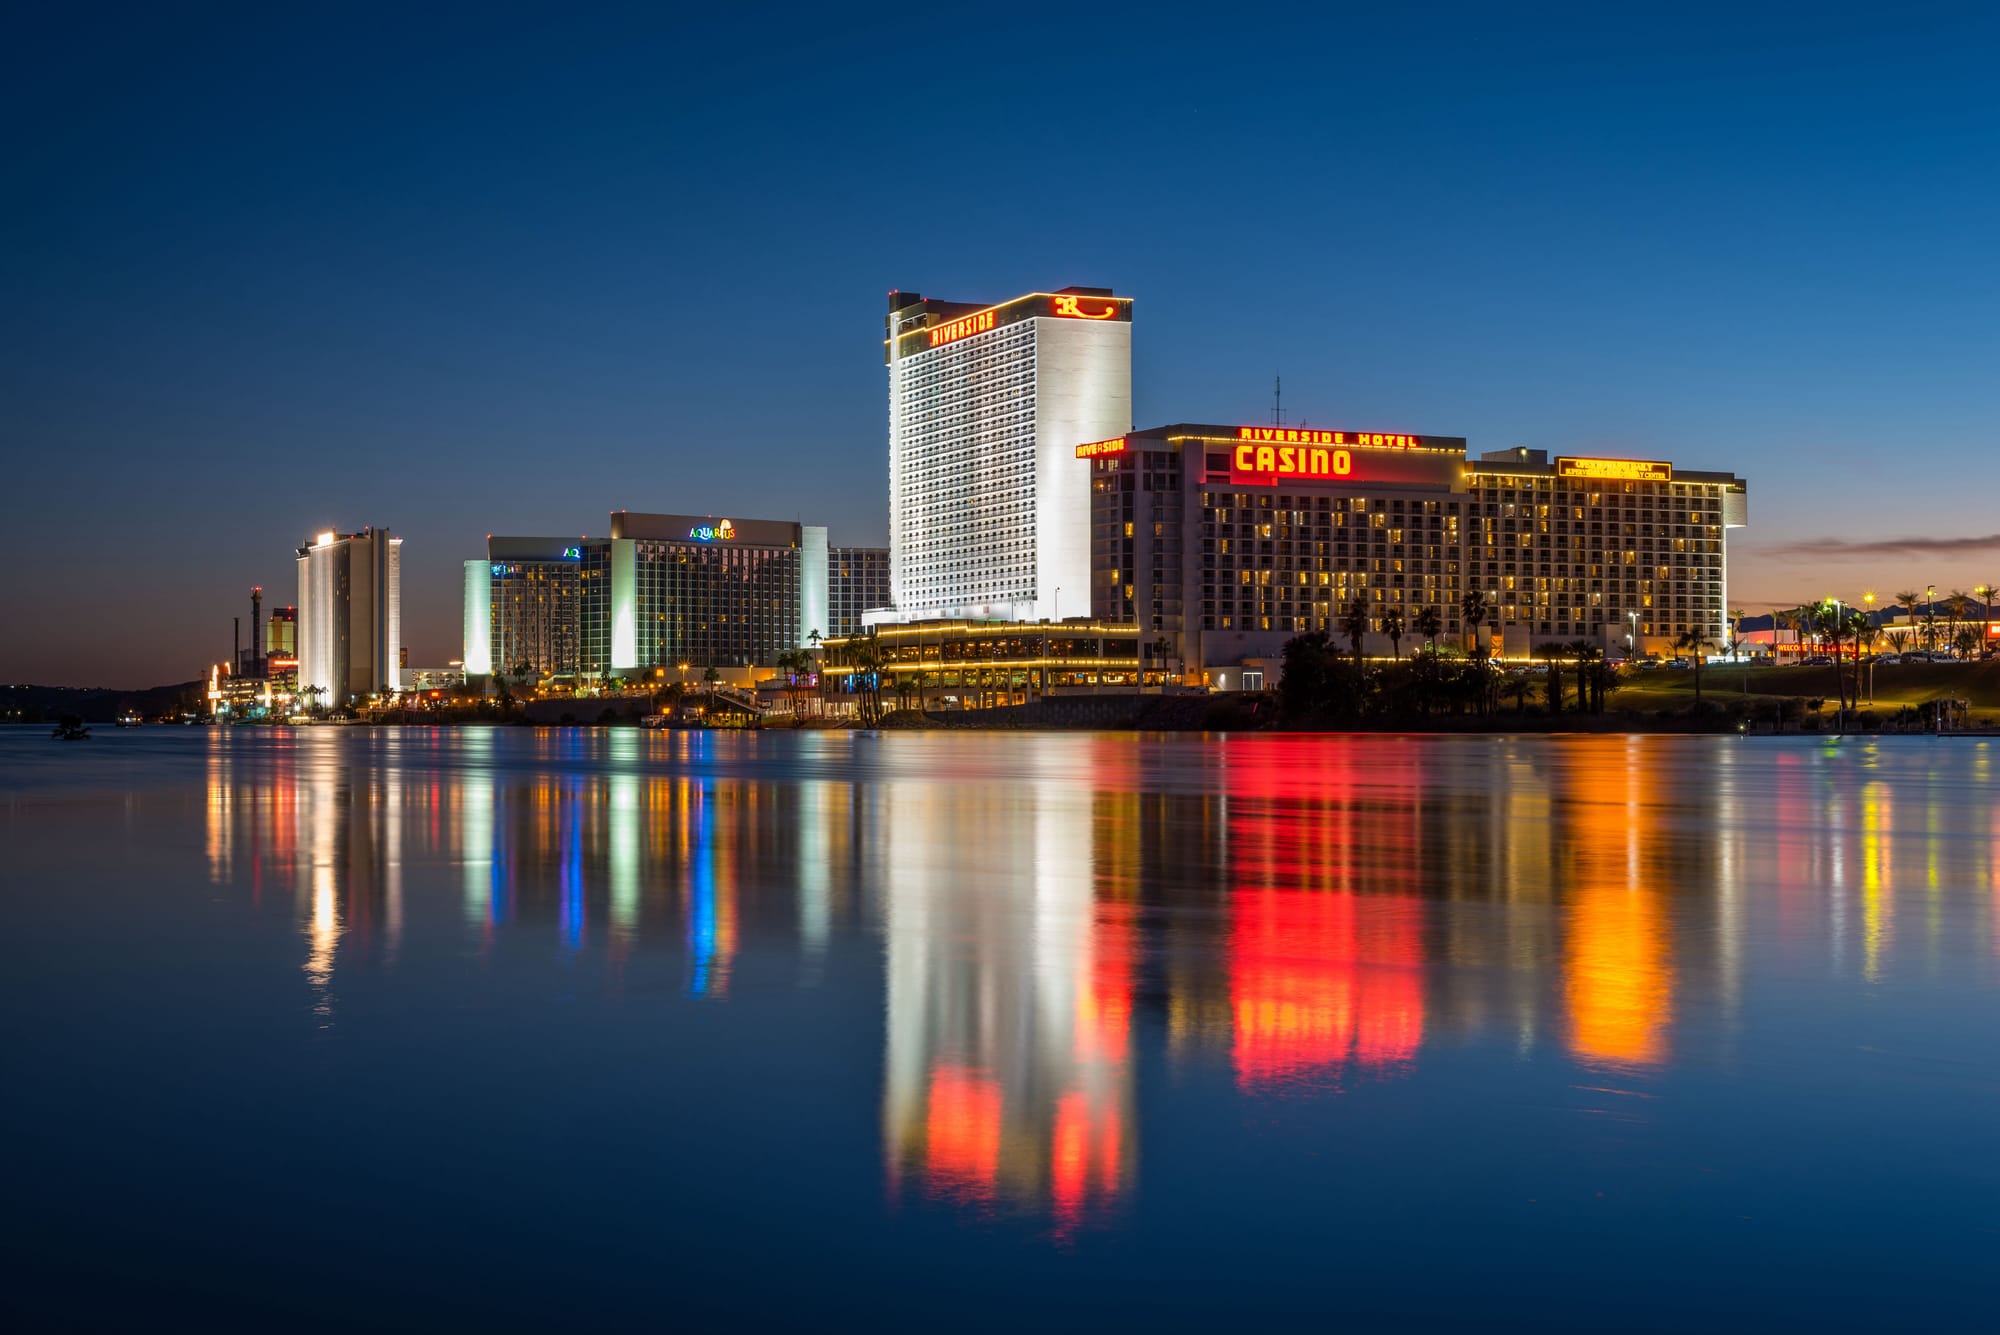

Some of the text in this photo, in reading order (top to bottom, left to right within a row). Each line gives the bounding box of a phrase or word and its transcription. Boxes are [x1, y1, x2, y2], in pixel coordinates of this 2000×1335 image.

[932, 312, 993, 345] RIVERSIDE
[1076, 439, 1125, 457] RIVERSIDE
[1241, 428, 1417, 447] RIVERSIDE HOTEL
[1236, 445, 1351, 475] CASINO
[689, 519, 736, 540] AQUARIUS
